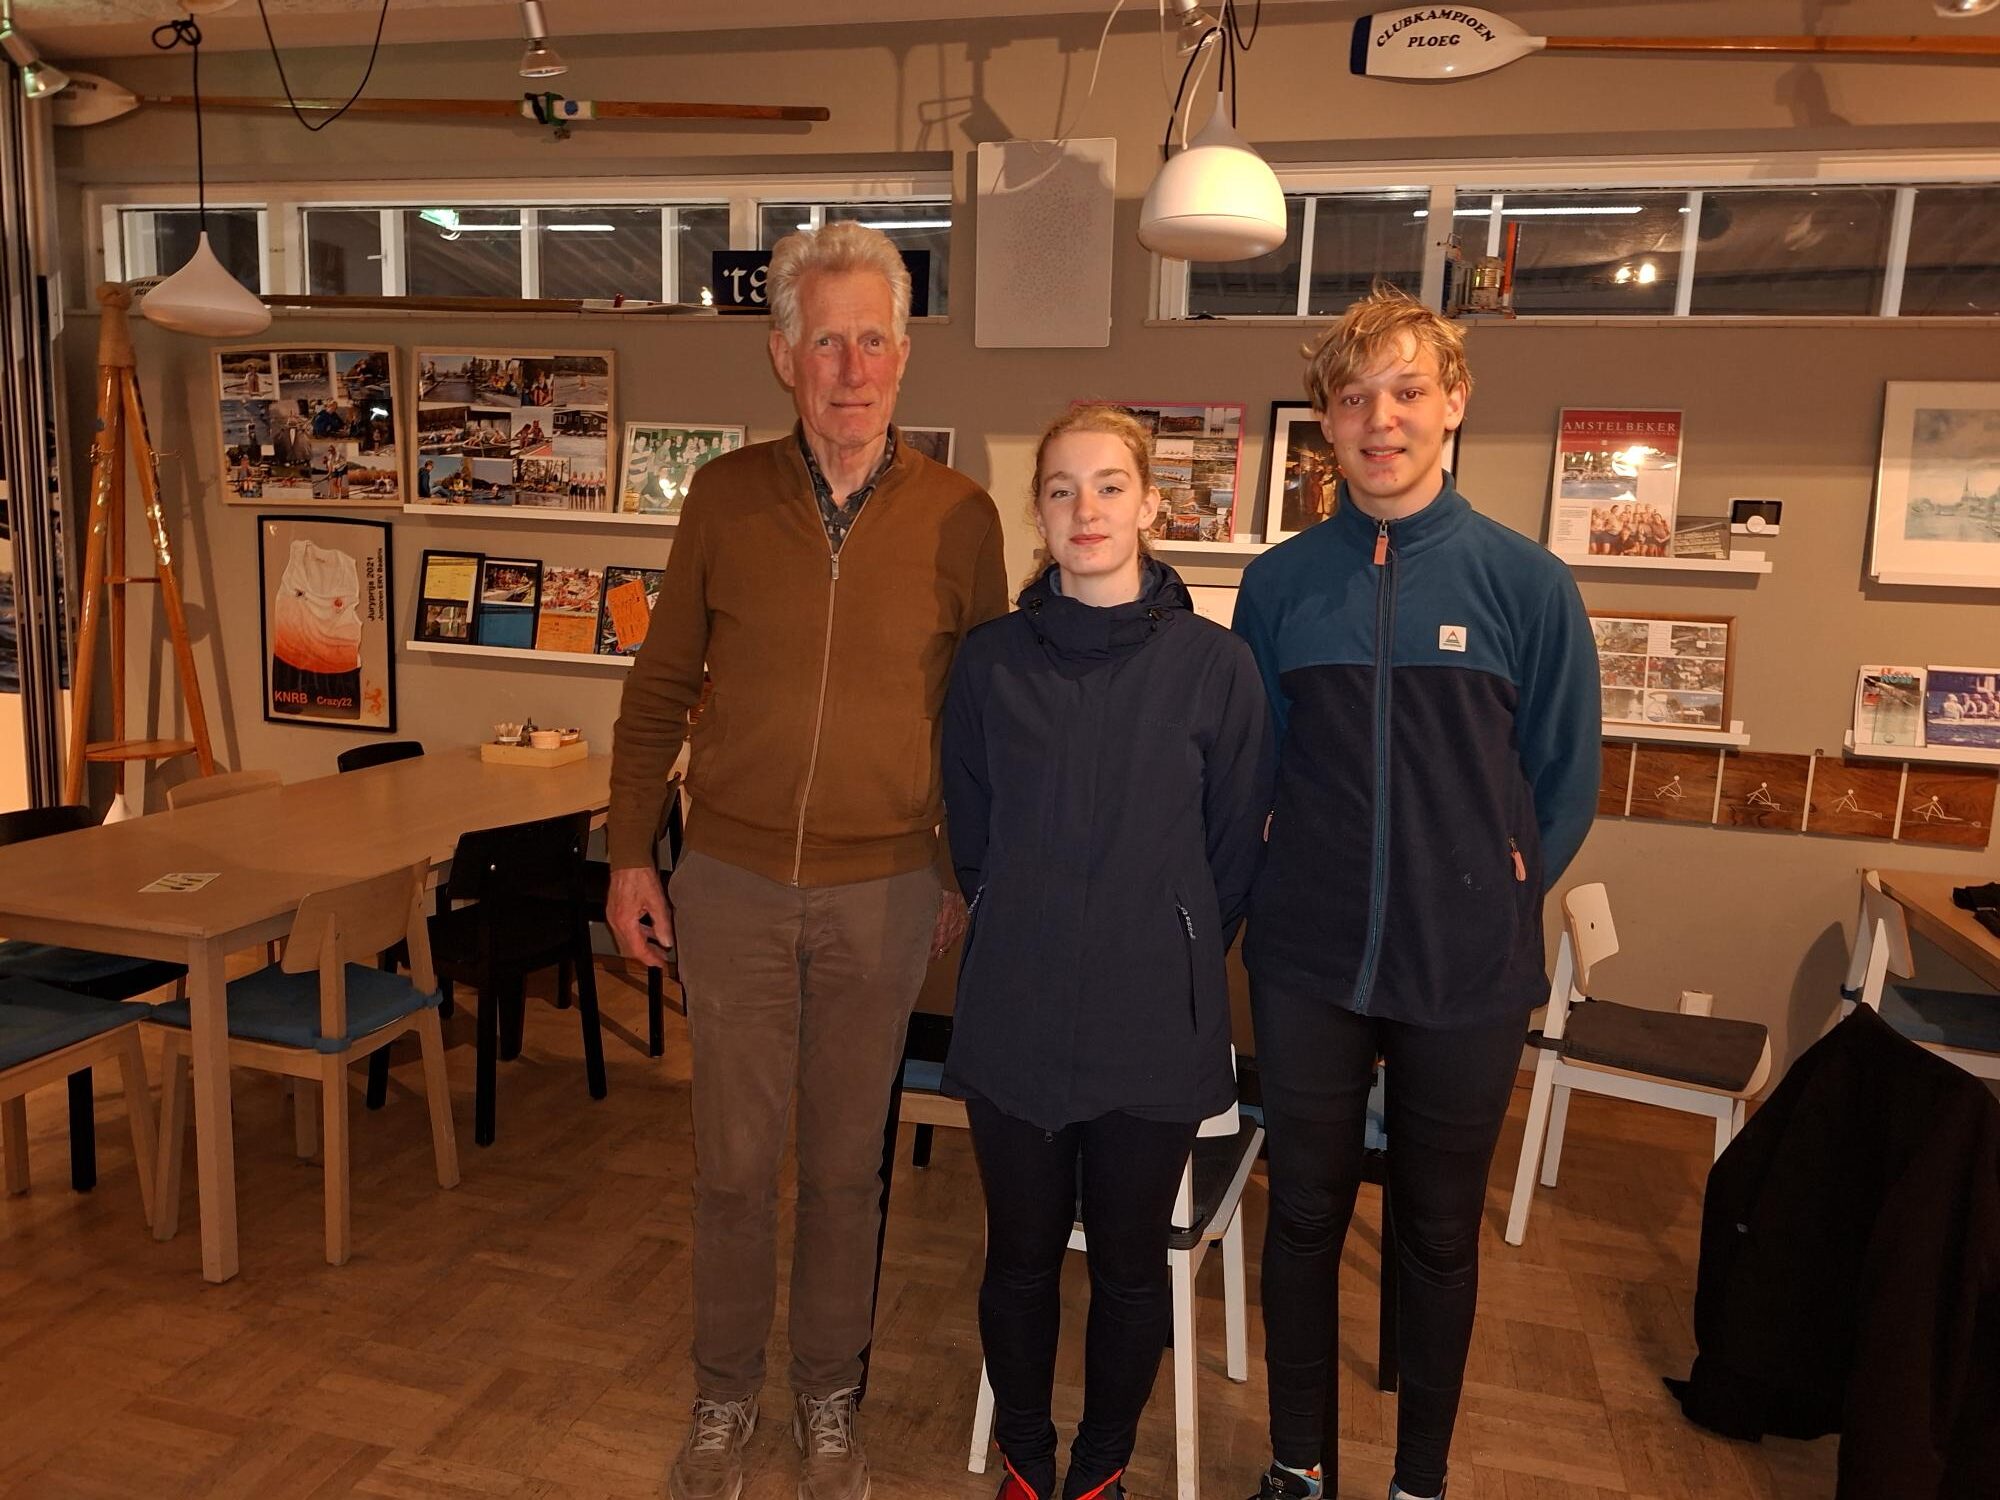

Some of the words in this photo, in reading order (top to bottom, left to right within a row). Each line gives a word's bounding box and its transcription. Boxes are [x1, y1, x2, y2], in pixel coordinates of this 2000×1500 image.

[1376, 9, 1496, 47] CLUBKAMPIOEN
[1407, 34, 1461, 47] PLOEG
[1563, 421, 1676, 432] AMSTELBEKER
[366, 556, 374, 578] 2021
[367, 580, 376, 621] Juryprijs
[274, 690, 308, 704] KNRB
[316, 696, 353, 708] Crazy22
